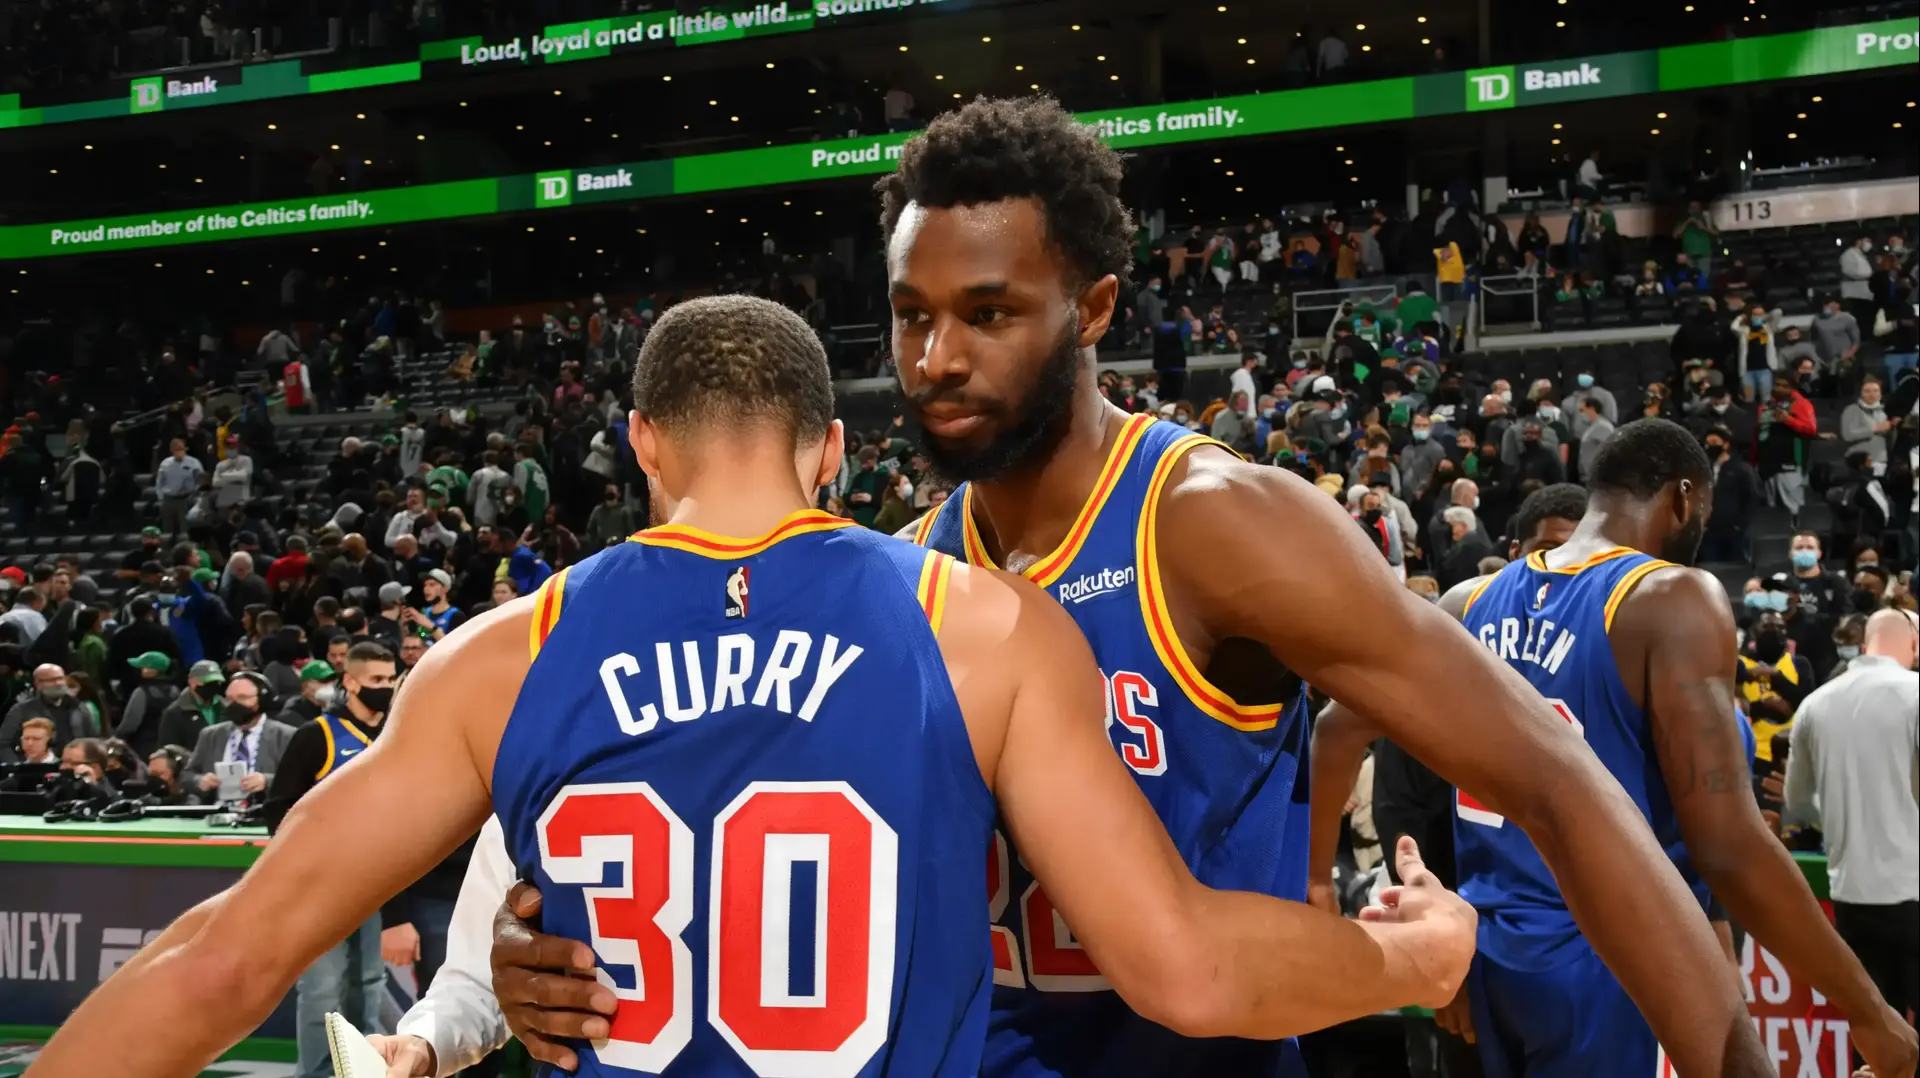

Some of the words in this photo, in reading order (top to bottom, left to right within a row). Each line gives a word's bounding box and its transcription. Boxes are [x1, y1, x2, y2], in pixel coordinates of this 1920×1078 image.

[461, 37, 528, 65] Loud,
[532, 28, 590, 56] loyal
[595, 21, 643, 45] and
[647, 23, 664, 40] a
[669, 11, 728, 37] little
[732, 1, 812, 29] wild...
[132, 83, 160, 107] TD
[167, 75, 218, 98] Bank
[1470, 74, 1510, 102] TD
[1524, 63, 1601, 90] Bank
[1156, 105, 1245, 131] family.
[812, 142, 880, 168] Proud
[539, 177, 568, 200] TD
[577, 168, 633, 191] Bank
[51, 224, 105, 245] Proud
[107, 219, 183, 241] member
[185, 215, 205, 233] of
[207, 213, 238, 231] the
[241, 206, 307, 228] Celtics
[309, 199, 375, 221] family.
[1732, 200, 1772, 222] 113
[1059, 565, 1135, 604] Rakuten
[725, 606, 741, 617] NBA
[1479, 616, 1577, 675] GREEN
[599, 629, 865, 736] CURRY
[0, 911, 82, 981] NEXT
[536, 781, 899, 1078] 30
